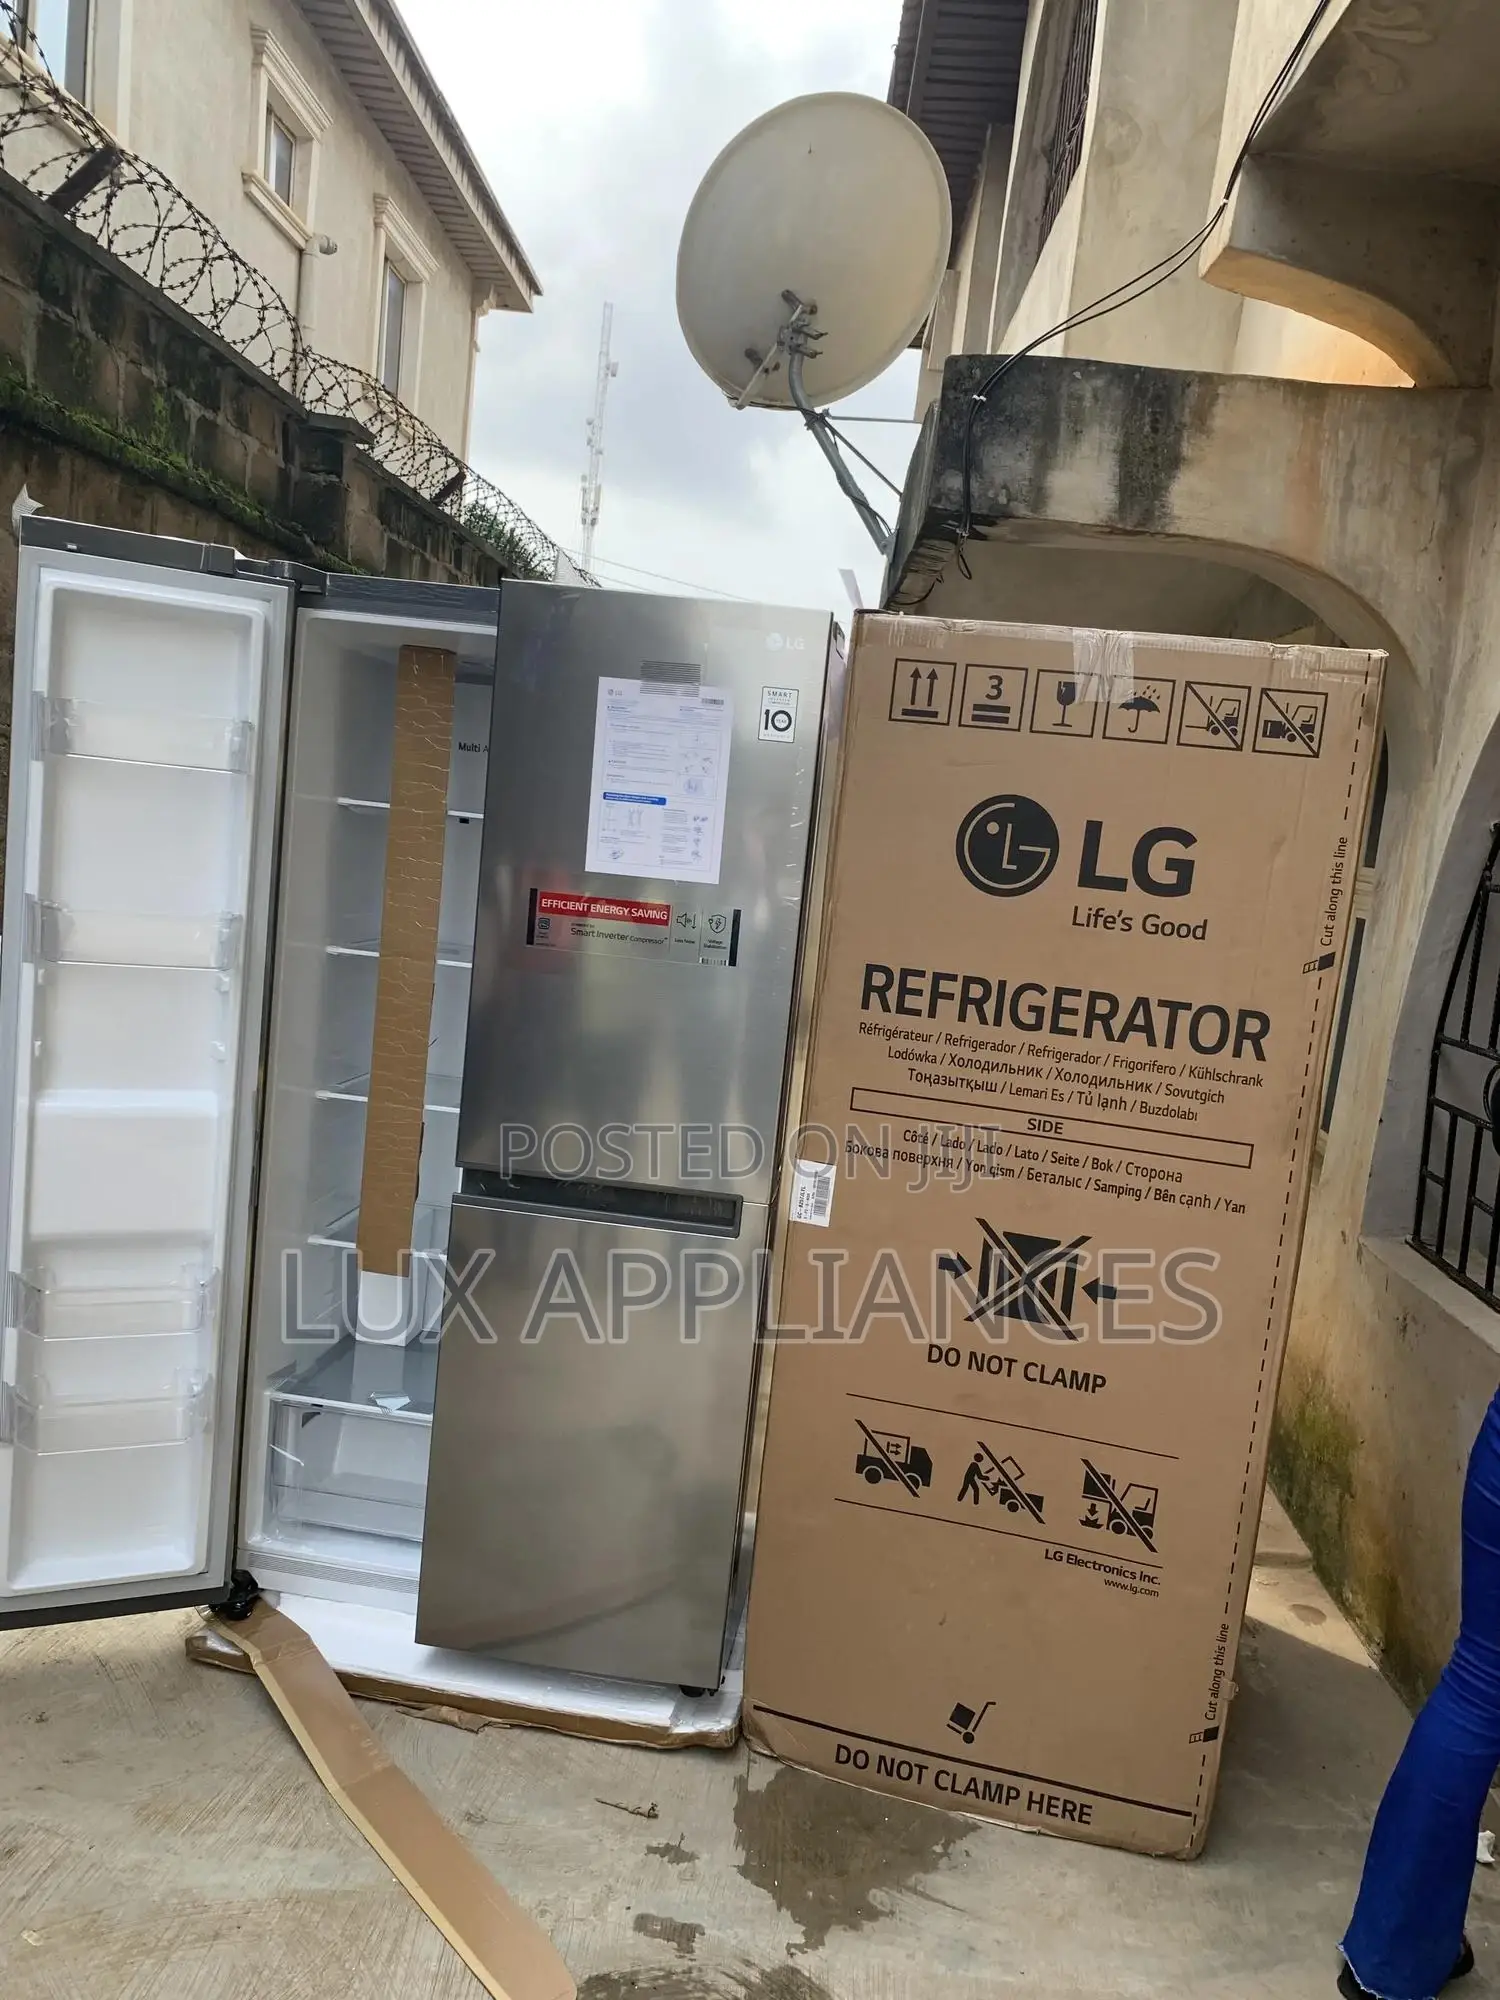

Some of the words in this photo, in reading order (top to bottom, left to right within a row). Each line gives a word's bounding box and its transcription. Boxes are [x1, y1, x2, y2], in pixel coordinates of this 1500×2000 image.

[785, 636, 805, 651] LG
[767, 690, 793, 699] SMART
[985, 674, 1003, 701] 3
[764, 708, 793, 732] 10
[458, 741, 481, 753] Multi
[1077, 819, 1198, 898] LG
[1333, 837, 1348, 858] line
[1330, 862, 1344, 885] this
[541, 898, 588, 912] EFFICIENT
[590, 904, 630, 916] ENERGY
[631, 908, 668, 920] SAVING
[1324, 888, 1343, 921] along
[570, 927, 595, 938] Smart
[596, 931, 629, 941] Inverter
[1072, 905, 1133, 932] Life's
[1141, 914, 1208, 940] Good
[1320, 926, 1335, 946] Cut
[860, 963, 1271, 1063] REFRIGERATOR
[858, 1022, 934, 1043] Réfrigérateur
[944, 1033, 1016, 1055] Refrigerador
[1027, 1043, 1101, 1066] Refrigerador
[1112, 1056, 1176, 1075] Frigorifero
[1188, 1065, 1264, 1087] Kühlschrank
[888, 1046, 937, 1064] Lodówka
[947, 1053, 1043, 1078] Холодильник
[1054, 1067, 1153, 1093] Холодильник
[1164, 1083, 1225, 1104] Sovutgich
[907, 1068, 998, 1093] Тоңазытқыш
[1009, 1083, 1048, 1100] Lemari
[1051, 1089, 1065, 1102] Es
[1077, 1091, 1094, 1106] Tủ
[1097, 1094, 1128, 1111] lạnh
[1027, 1118, 1064, 1135] SIDE
[903, 1130, 929, 1145] Côté
[940, 1134, 966, 1150] Lado
[977, 1140, 1003, 1156] Lado
[1014, 1145, 1040, 1161] Lato
[1050, 1151, 1080, 1167] Seite
[1091, 1157, 1113, 1173] Bok
[1125, 1162, 1183, 1183] Сторона
[845, 1140, 889, 1159] Бокова
[892, 1148, 954, 1169] поверхня
[965, 1158, 986, 1174] Yon
[989, 1163, 1015, 1179] qism
[1027, 1167, 1082, 1189] Беталыс
[1093, 1179, 1142, 1201] Samping
[1153, 1188, 1176, 1204] Bên
[1179, 1193, 1211, 1209] cạnh
[1224, 1199, 1246, 1214] Yan
[927, 1343, 961, 1368] DO
[967, 1351, 1018, 1378] NOT
[1023, 1362, 1107, 1394] CLAMP
[1044, 1548, 1064, 1563] LG
[1066, 1552, 1137, 1581] Electronics
[1139, 1570, 1161, 1586] Inc.
[1104, 1577, 1160, 1598] www.lg.com
[1216, 1623, 1229, 1643] line
[1213, 1645, 1226, 1666] this
[1208, 1668, 1225, 1699] along
[1204, 1702, 1218, 1720] Cut
[835, 1743, 869, 1770] DO
[876, 1754, 929, 1785] NOT
[934, 1769, 1021, 1806] CLAMP
[1026, 1790, 1093, 1825] HERE
